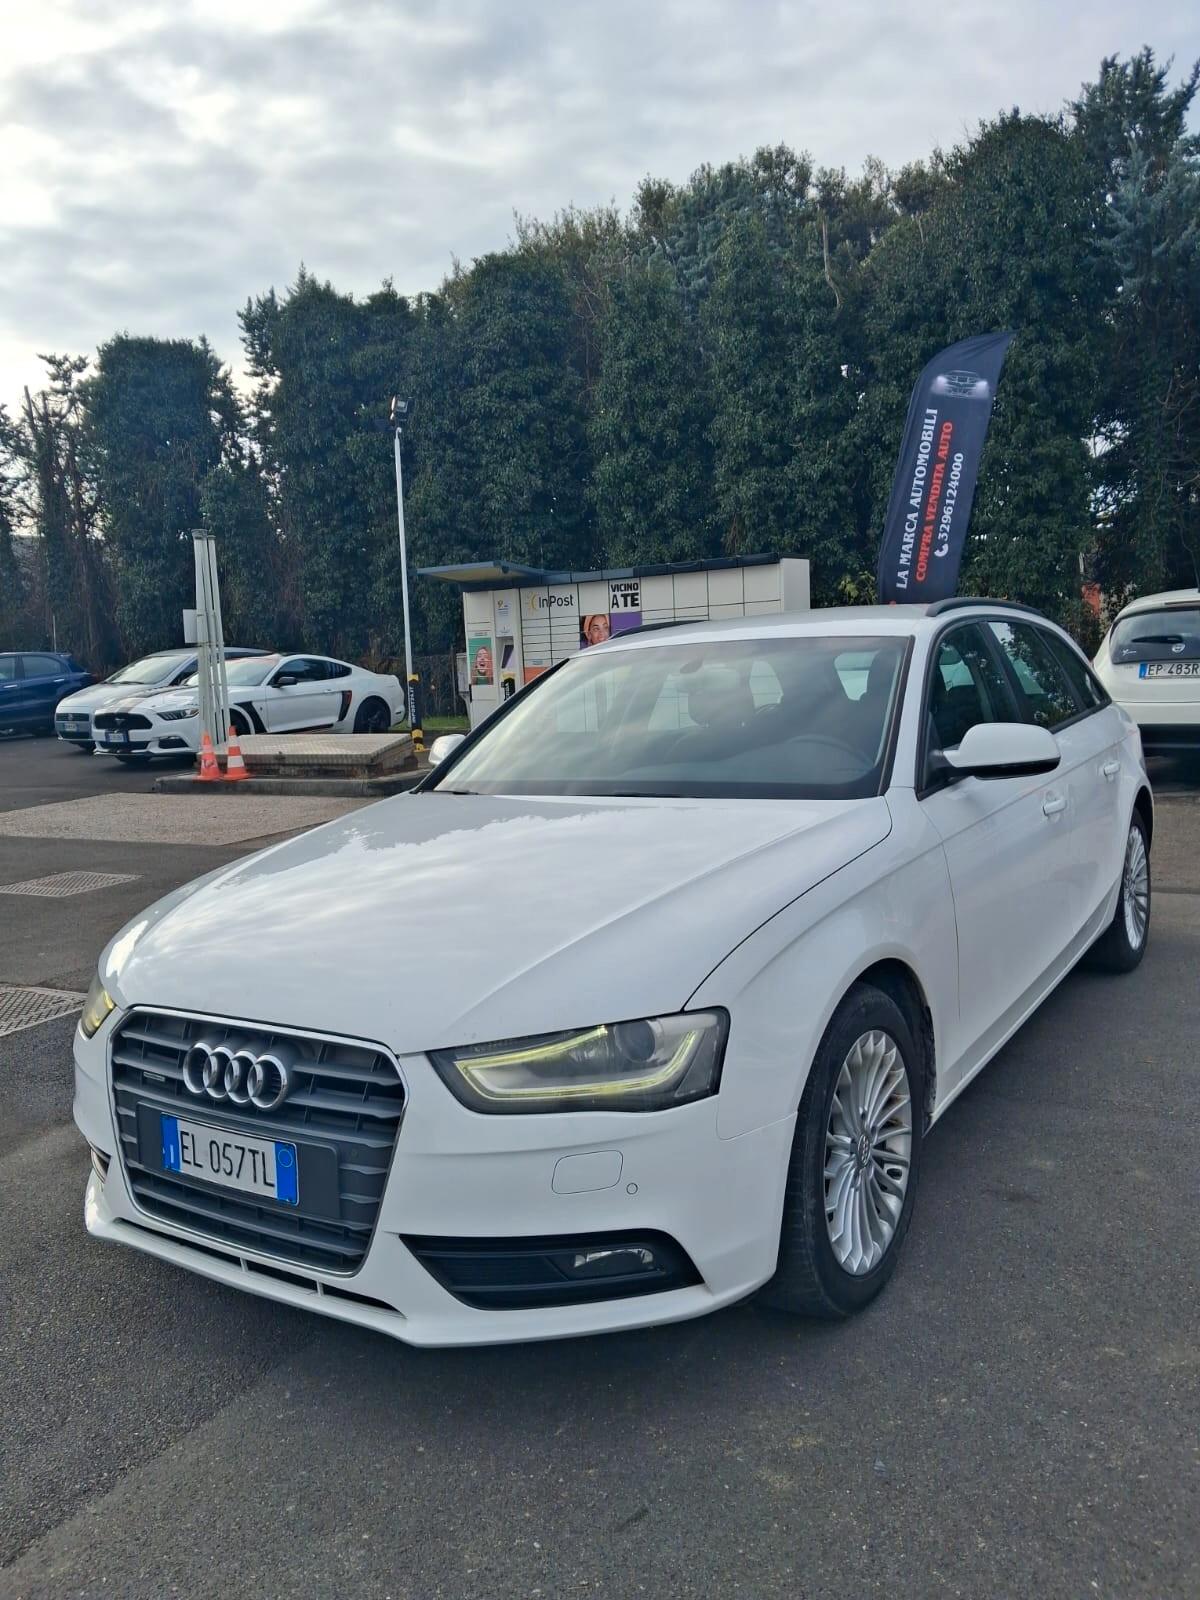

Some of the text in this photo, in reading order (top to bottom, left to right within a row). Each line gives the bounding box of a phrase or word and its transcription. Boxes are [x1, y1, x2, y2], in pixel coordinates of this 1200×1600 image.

[896, 408, 938, 589] LA MARCA AUTOMOBILI
[916, 421, 953, 581] COMPRA VENDITA AUTO
[937, 452, 964, 542] 3296124000
[538, 594, 574, 609] InPost
[610, 582, 639, 593] VICINO
[611, 592, 640, 608] A TE
[1147, 664, 1163, 676] EP
[180, 1130, 203, 1169] EL
[209, 1140, 275, 1188] 057TL
